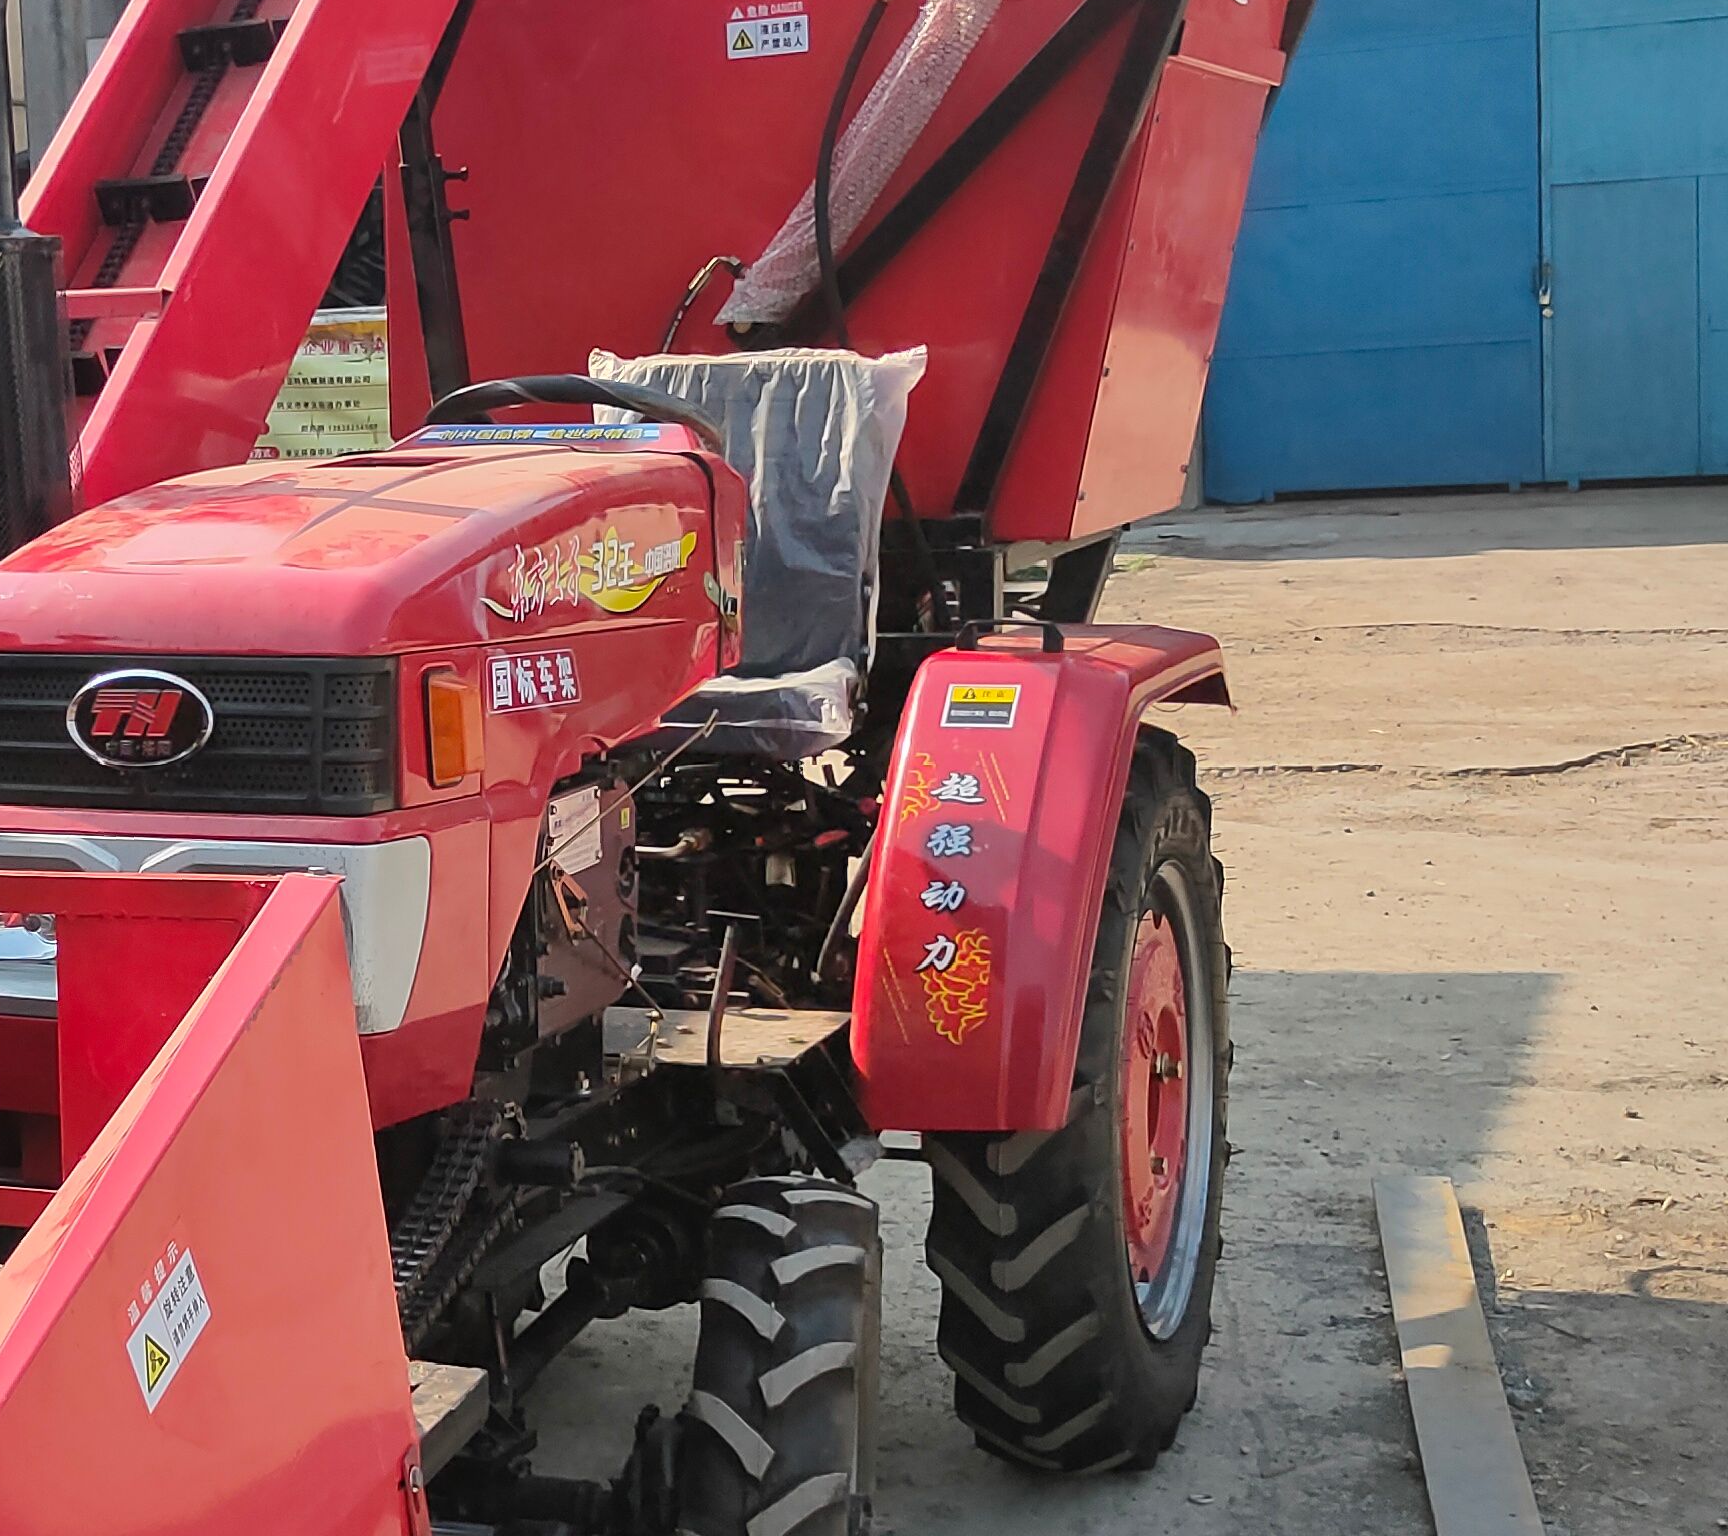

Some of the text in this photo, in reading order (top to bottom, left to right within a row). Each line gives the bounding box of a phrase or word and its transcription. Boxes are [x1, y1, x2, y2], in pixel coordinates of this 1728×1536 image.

[491, 653, 577, 710] 国标车架
[914, 772, 987, 972] 超强动力
